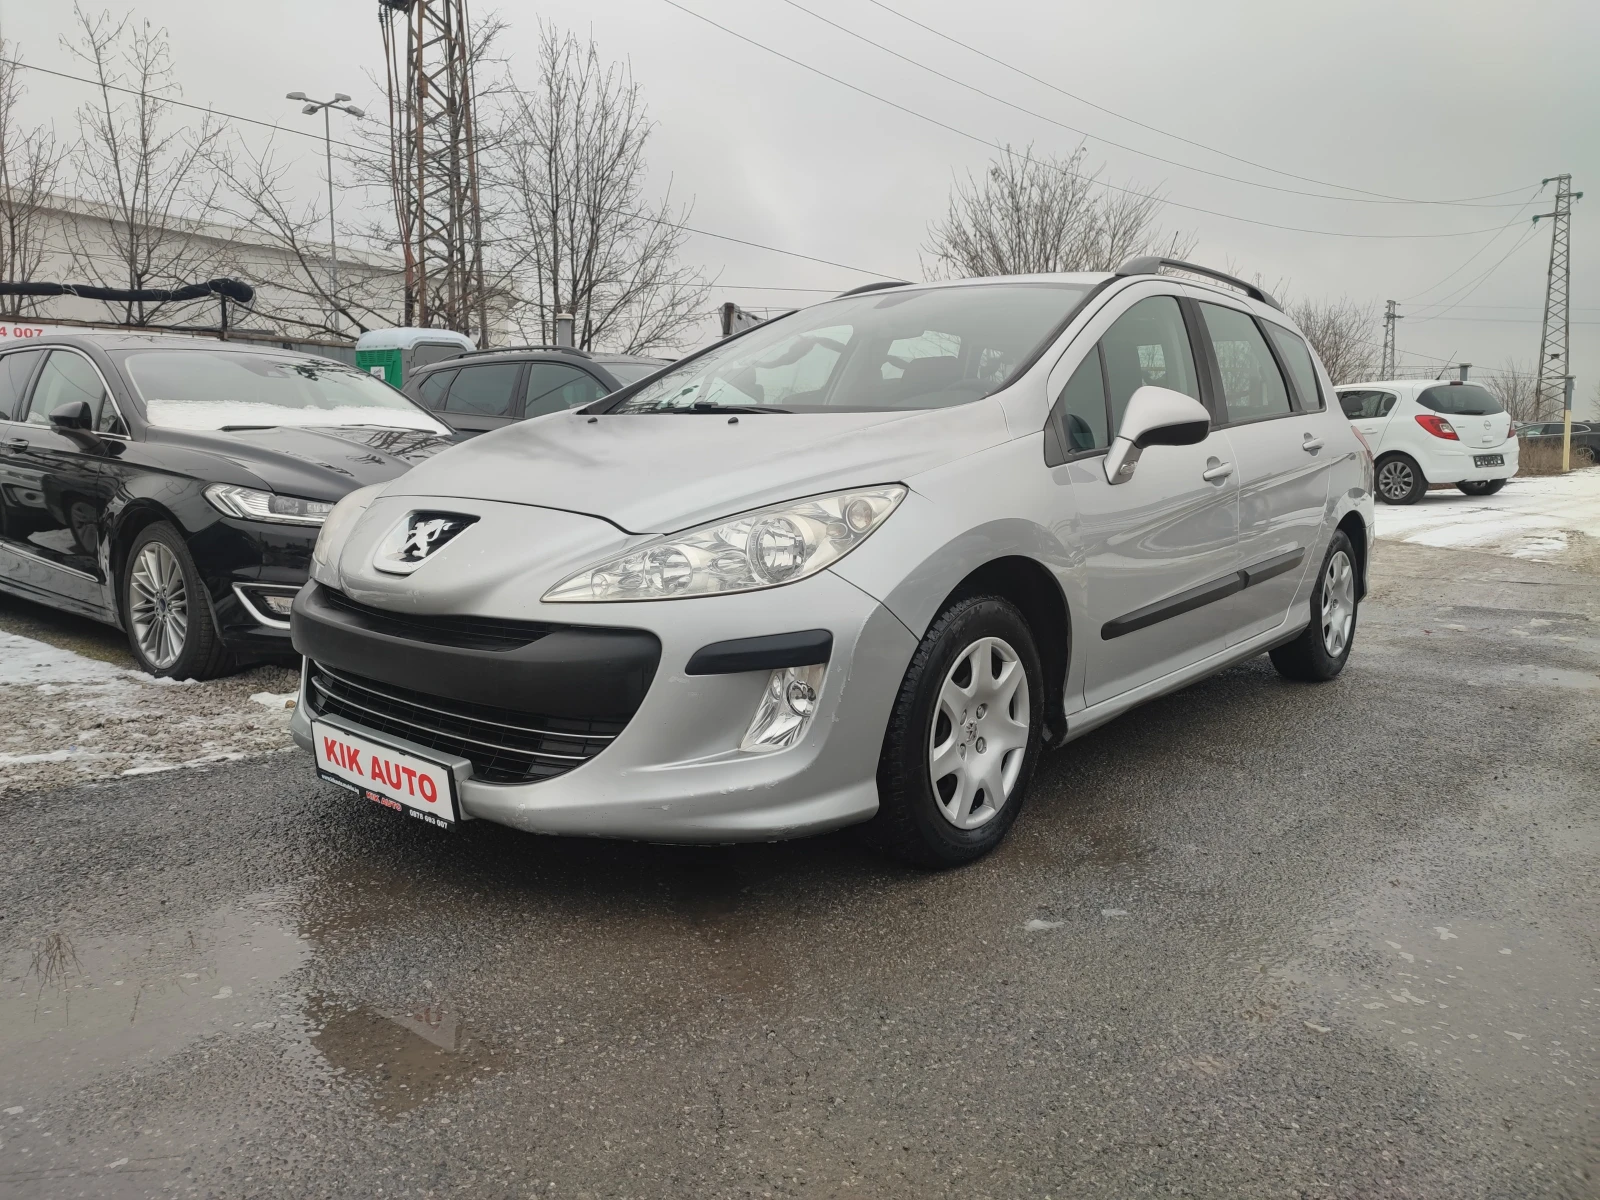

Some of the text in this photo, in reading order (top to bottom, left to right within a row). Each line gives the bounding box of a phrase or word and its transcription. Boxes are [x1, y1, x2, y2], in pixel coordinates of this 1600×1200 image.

[13, 327, 43, 338] 007
[324, 736, 364, 776] KIK
[371, 755, 438, 803] AUTO
[381, 797, 402, 812] AUTO
